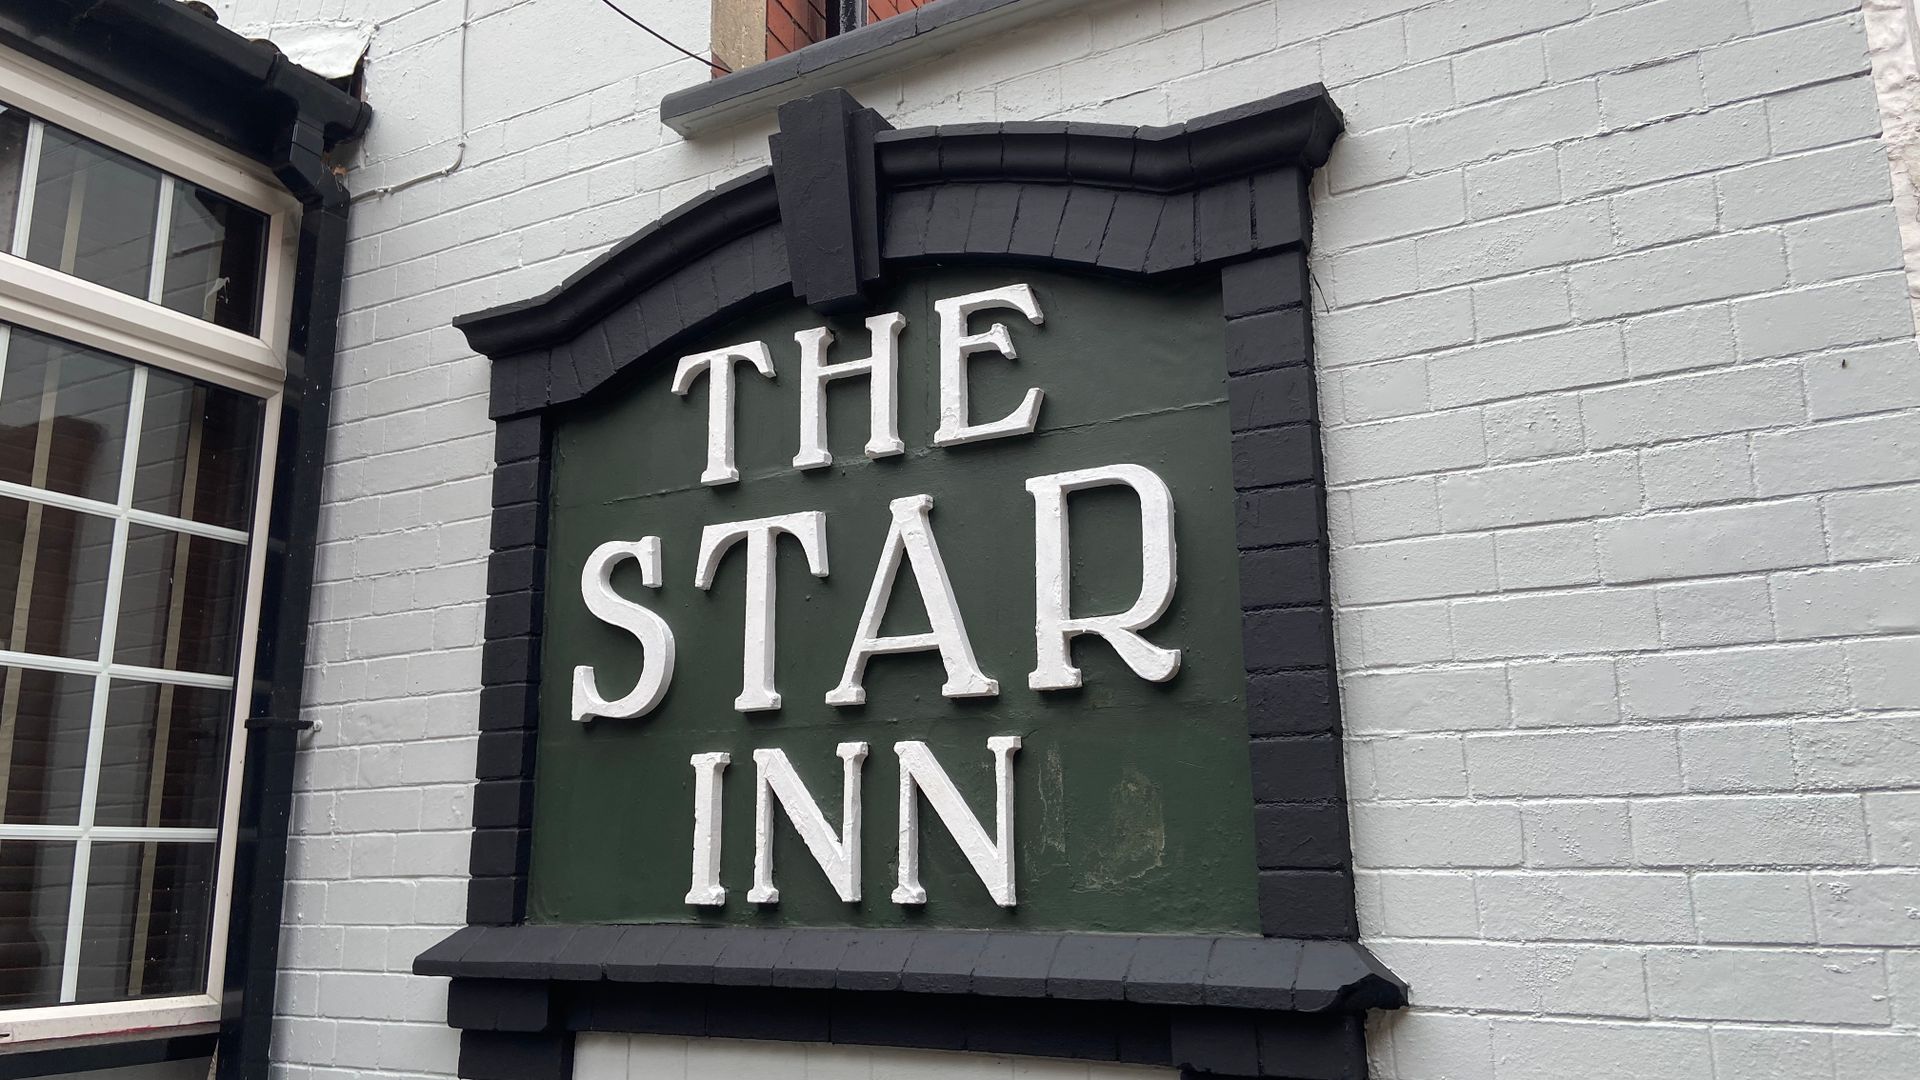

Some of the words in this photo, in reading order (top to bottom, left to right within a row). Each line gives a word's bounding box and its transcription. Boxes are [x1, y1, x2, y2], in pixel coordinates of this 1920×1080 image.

[671, 283, 1045, 487] THE
[571, 463, 1182, 722] STAR
[684, 735, 1022, 908] INN
